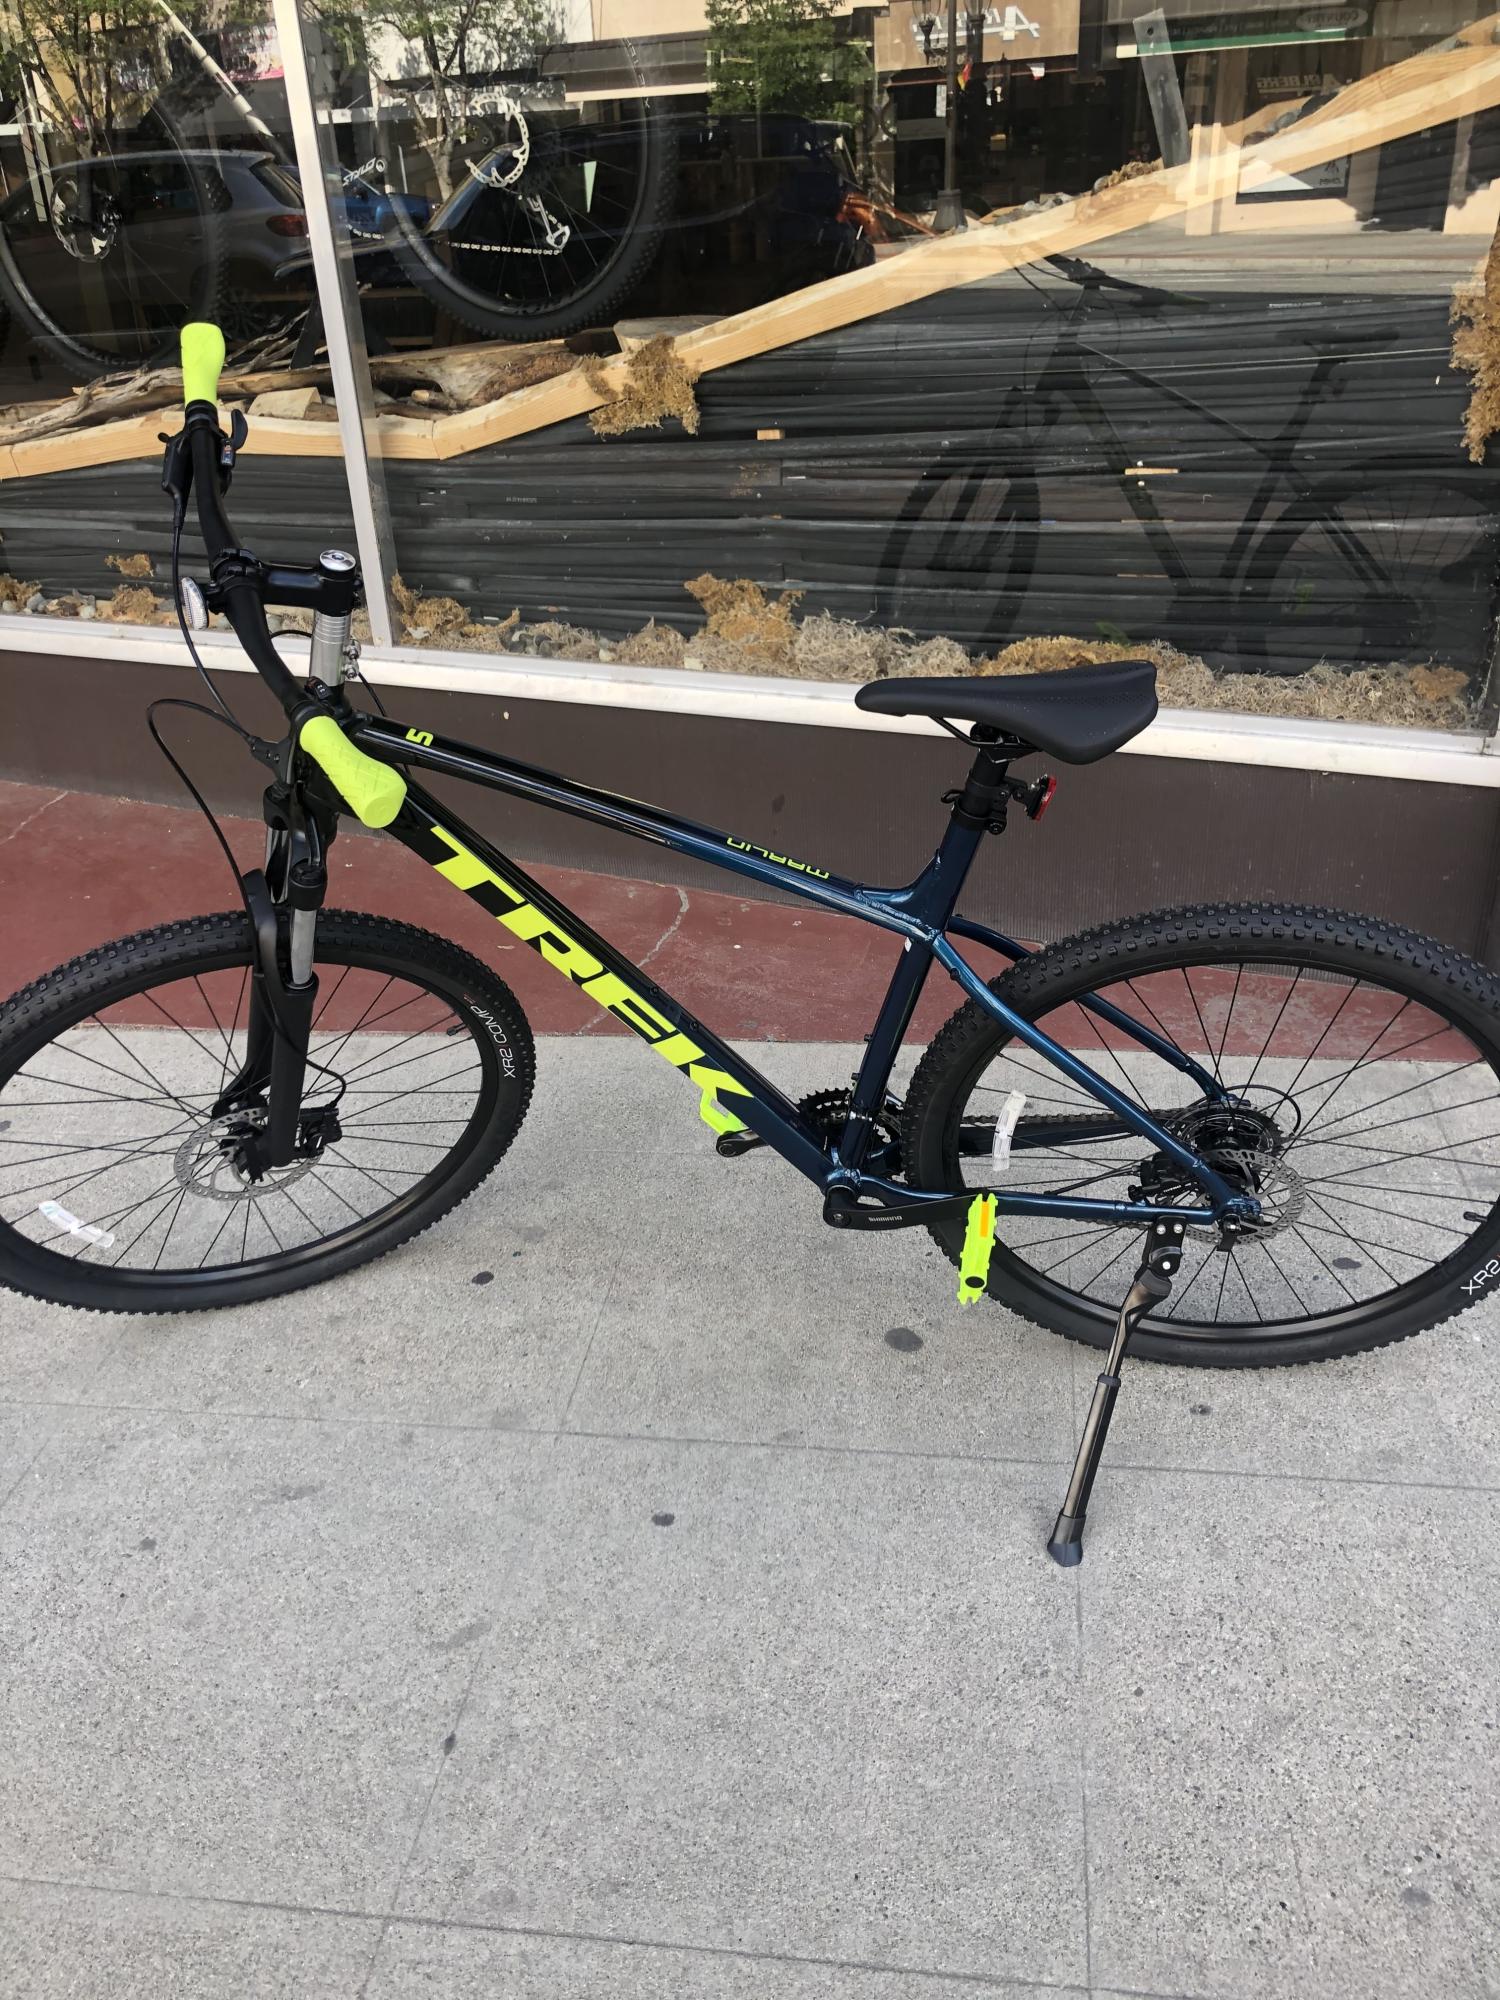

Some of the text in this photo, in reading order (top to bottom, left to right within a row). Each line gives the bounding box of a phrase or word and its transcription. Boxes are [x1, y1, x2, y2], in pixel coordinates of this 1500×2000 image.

[406, 727, 433, 747] 5
[726, 837, 829, 879] MARLIN
[431, 825, 753, 1098] TREK
[470, 1005, 516, 1078] XR2 COMP
[1460, 1259, 1500, 1296] XR2
